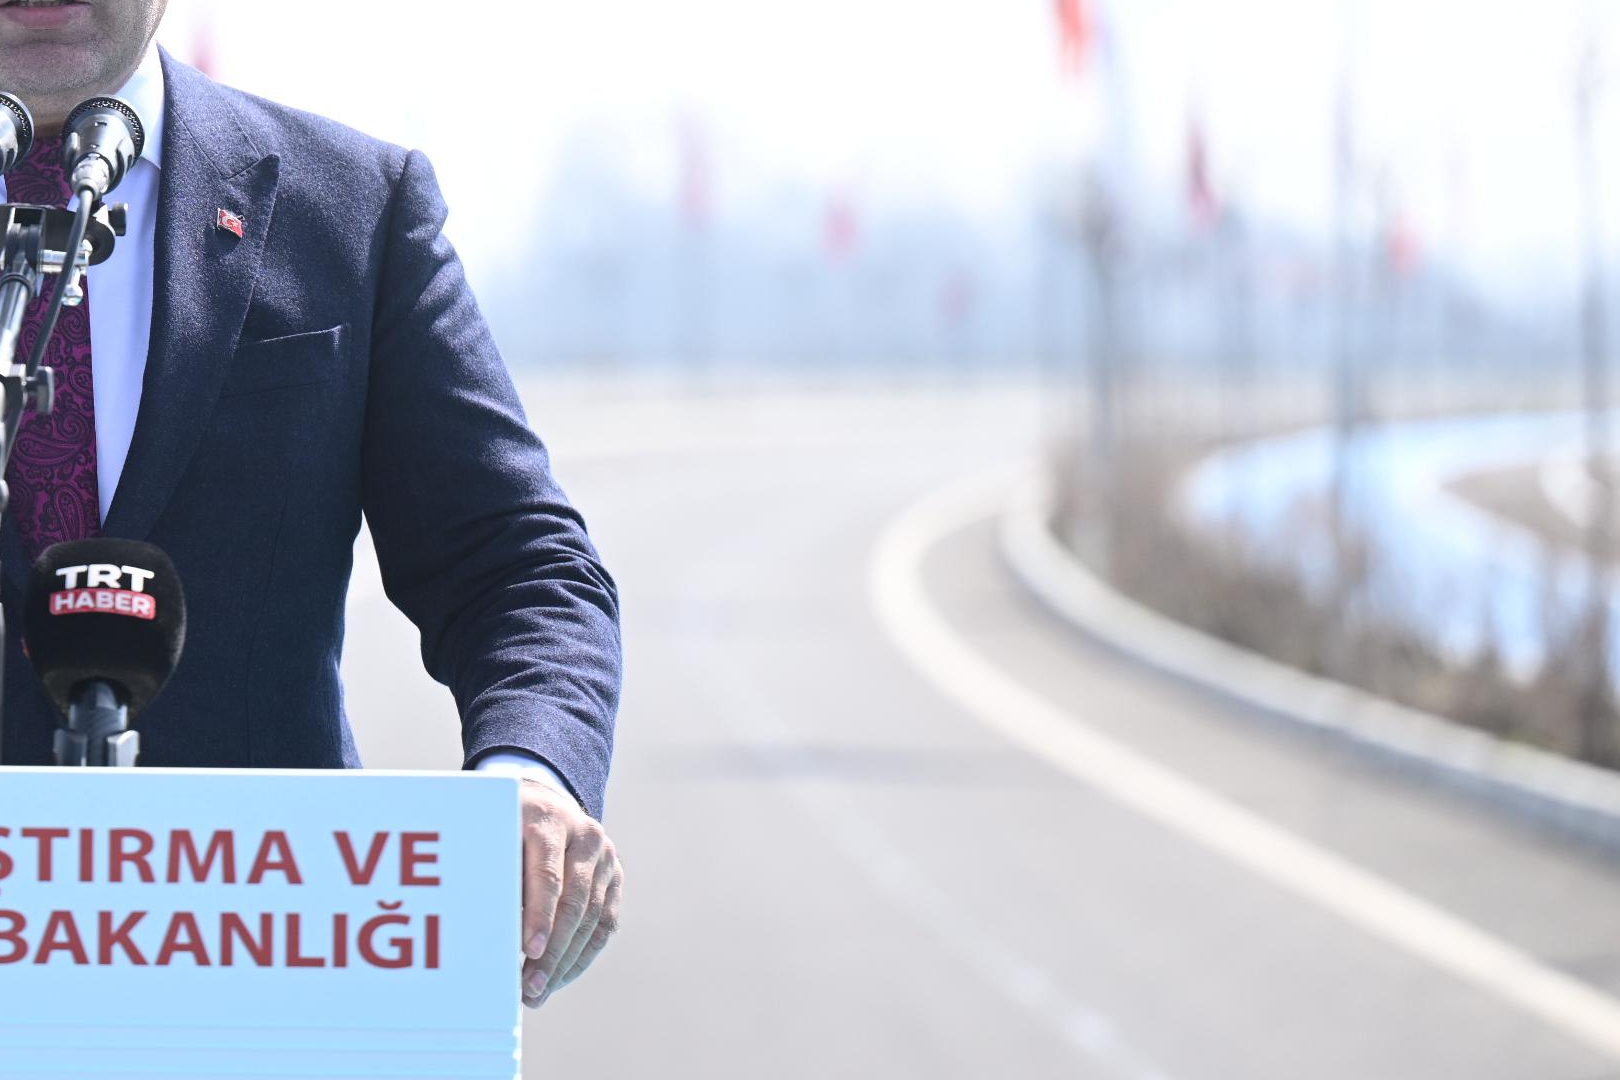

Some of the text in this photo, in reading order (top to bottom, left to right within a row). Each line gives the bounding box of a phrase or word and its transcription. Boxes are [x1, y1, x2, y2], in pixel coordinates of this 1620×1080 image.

[55, 564, 155, 591] TRT
[54, 592, 151, 616] HABER
[334, 830, 441, 887] VE
